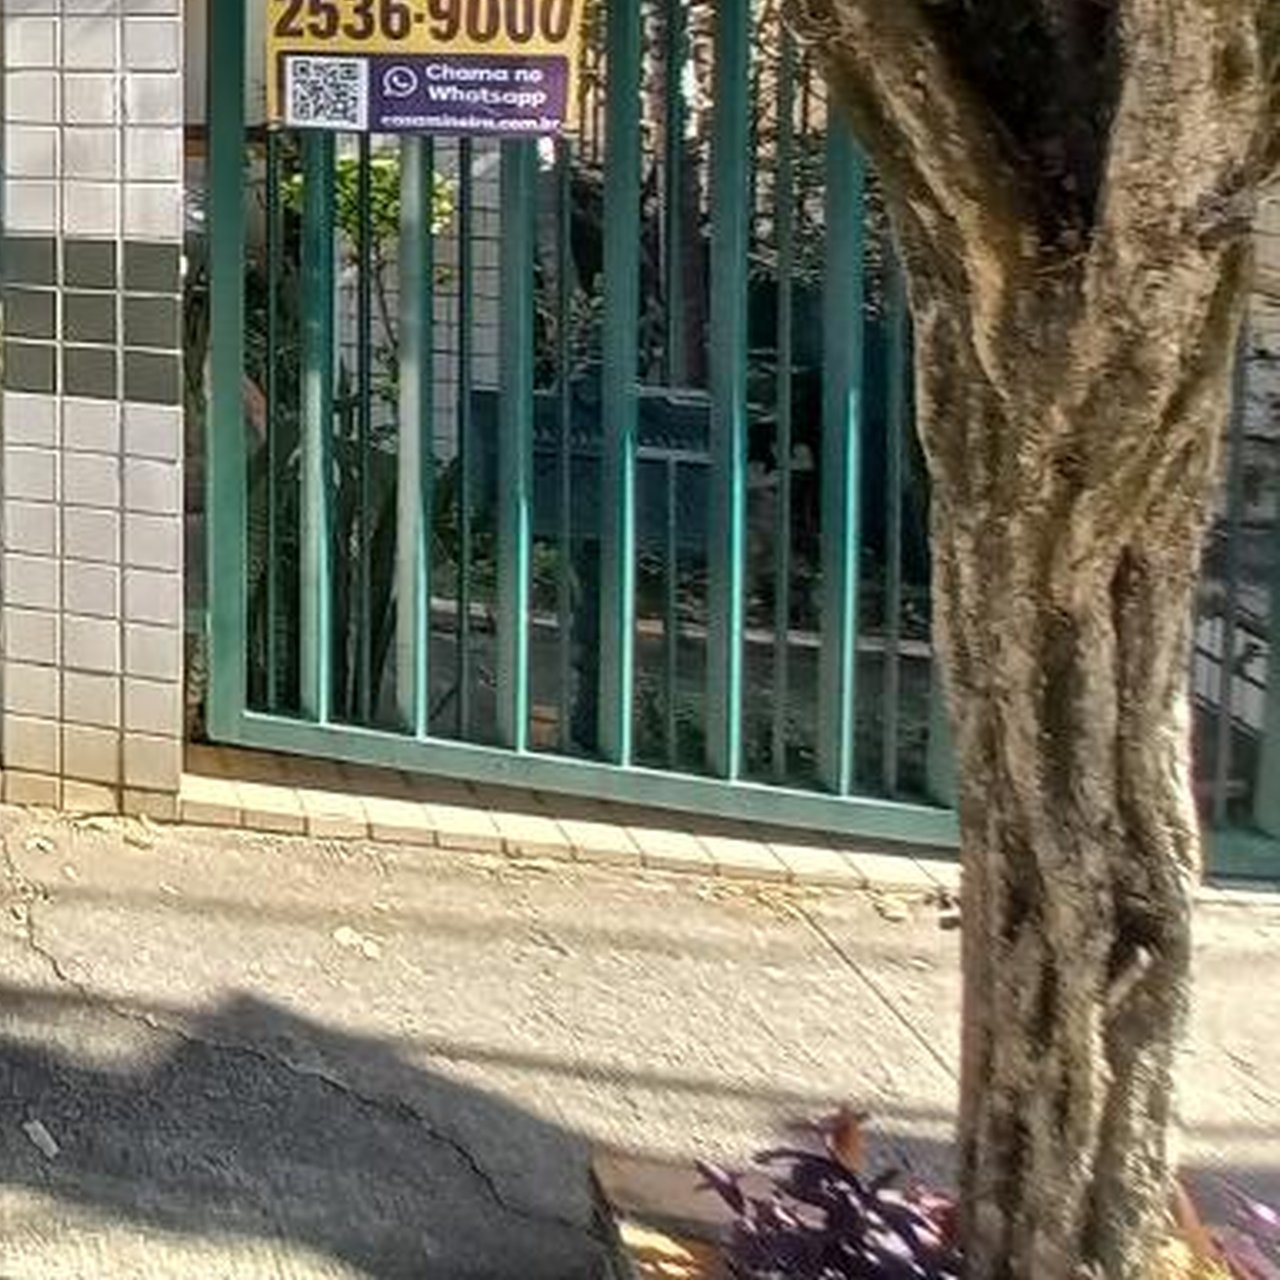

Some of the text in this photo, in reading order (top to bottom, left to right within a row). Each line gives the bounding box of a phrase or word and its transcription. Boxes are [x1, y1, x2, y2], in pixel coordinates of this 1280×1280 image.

[425, 63, 544, 83] Chama no
[428, 84, 547, 108] Whatsapp
